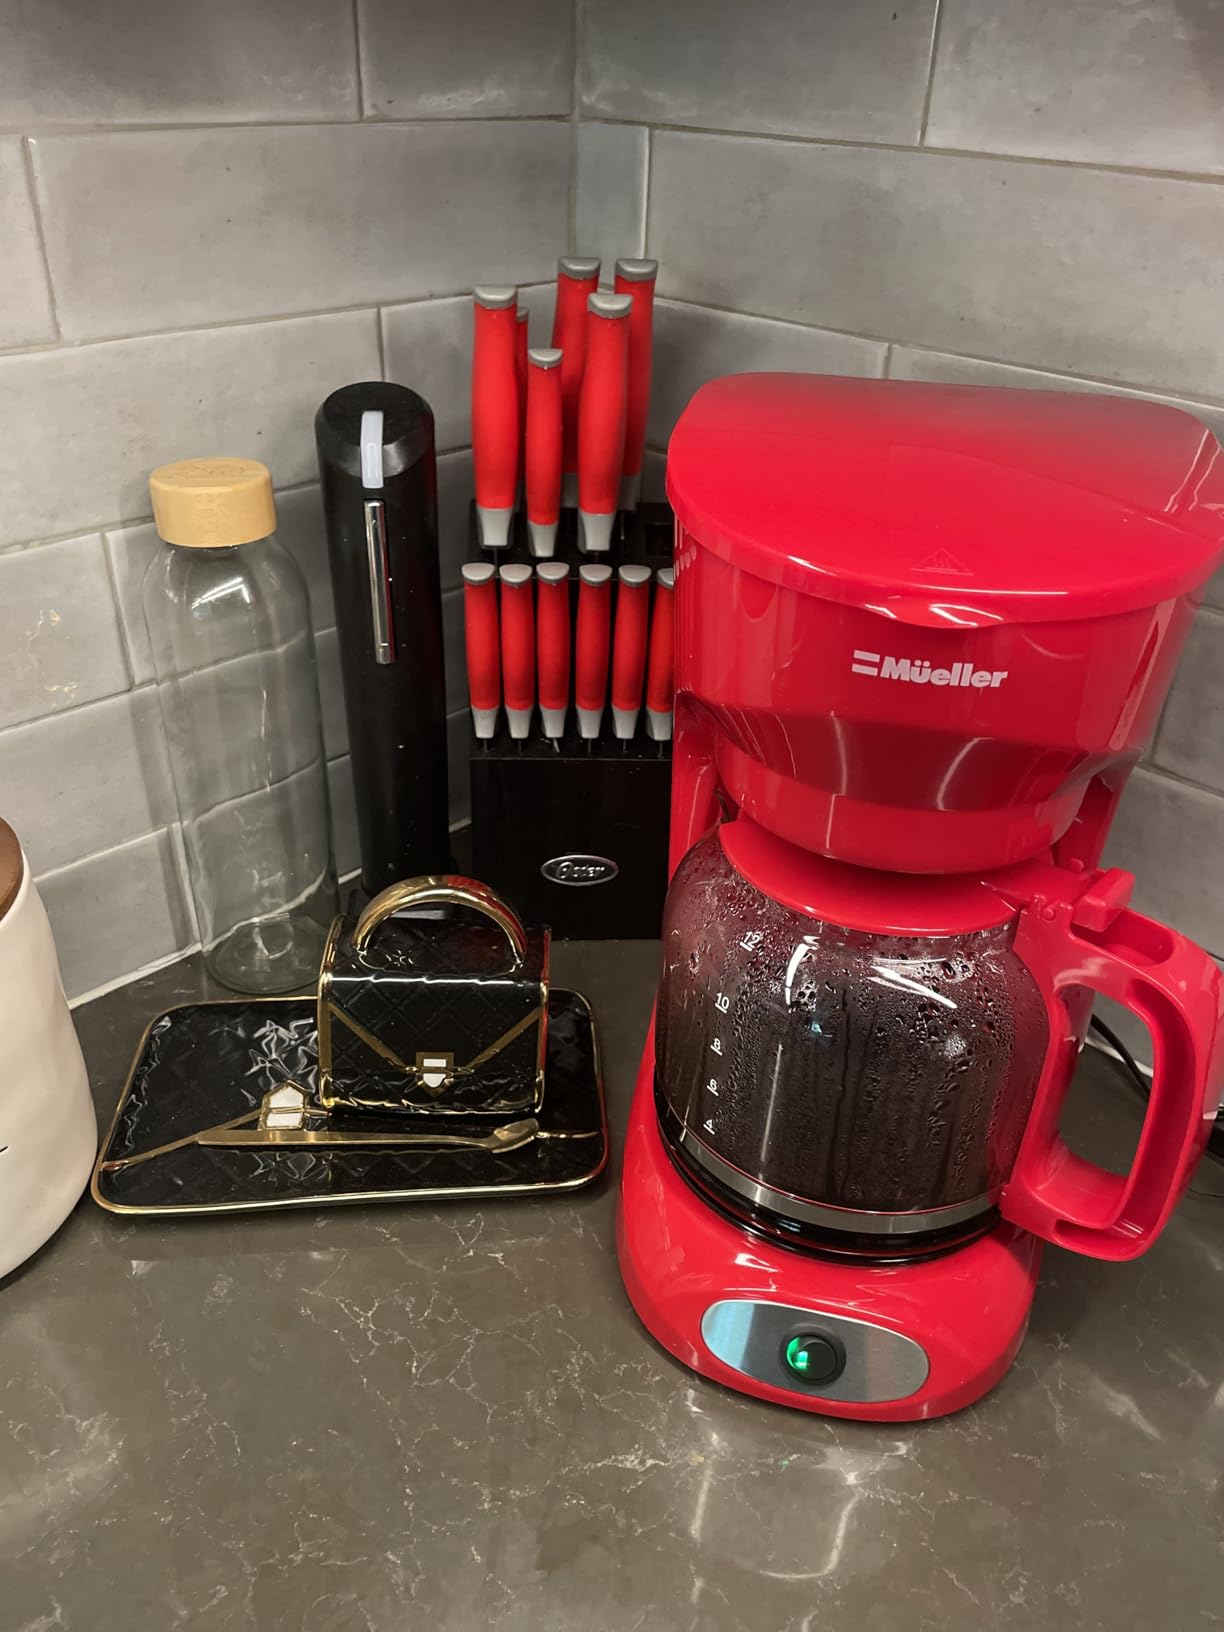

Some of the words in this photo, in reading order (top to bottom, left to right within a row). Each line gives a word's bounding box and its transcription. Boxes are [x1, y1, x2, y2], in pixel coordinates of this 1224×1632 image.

[880, 656, 1008, 687] Müeller
[743, 931, 760, 949] 12
[716, 992, 730, 1011] 10
[712, 1037, 721, 1052] 8
[709, 1078, 718, 1092] 6
